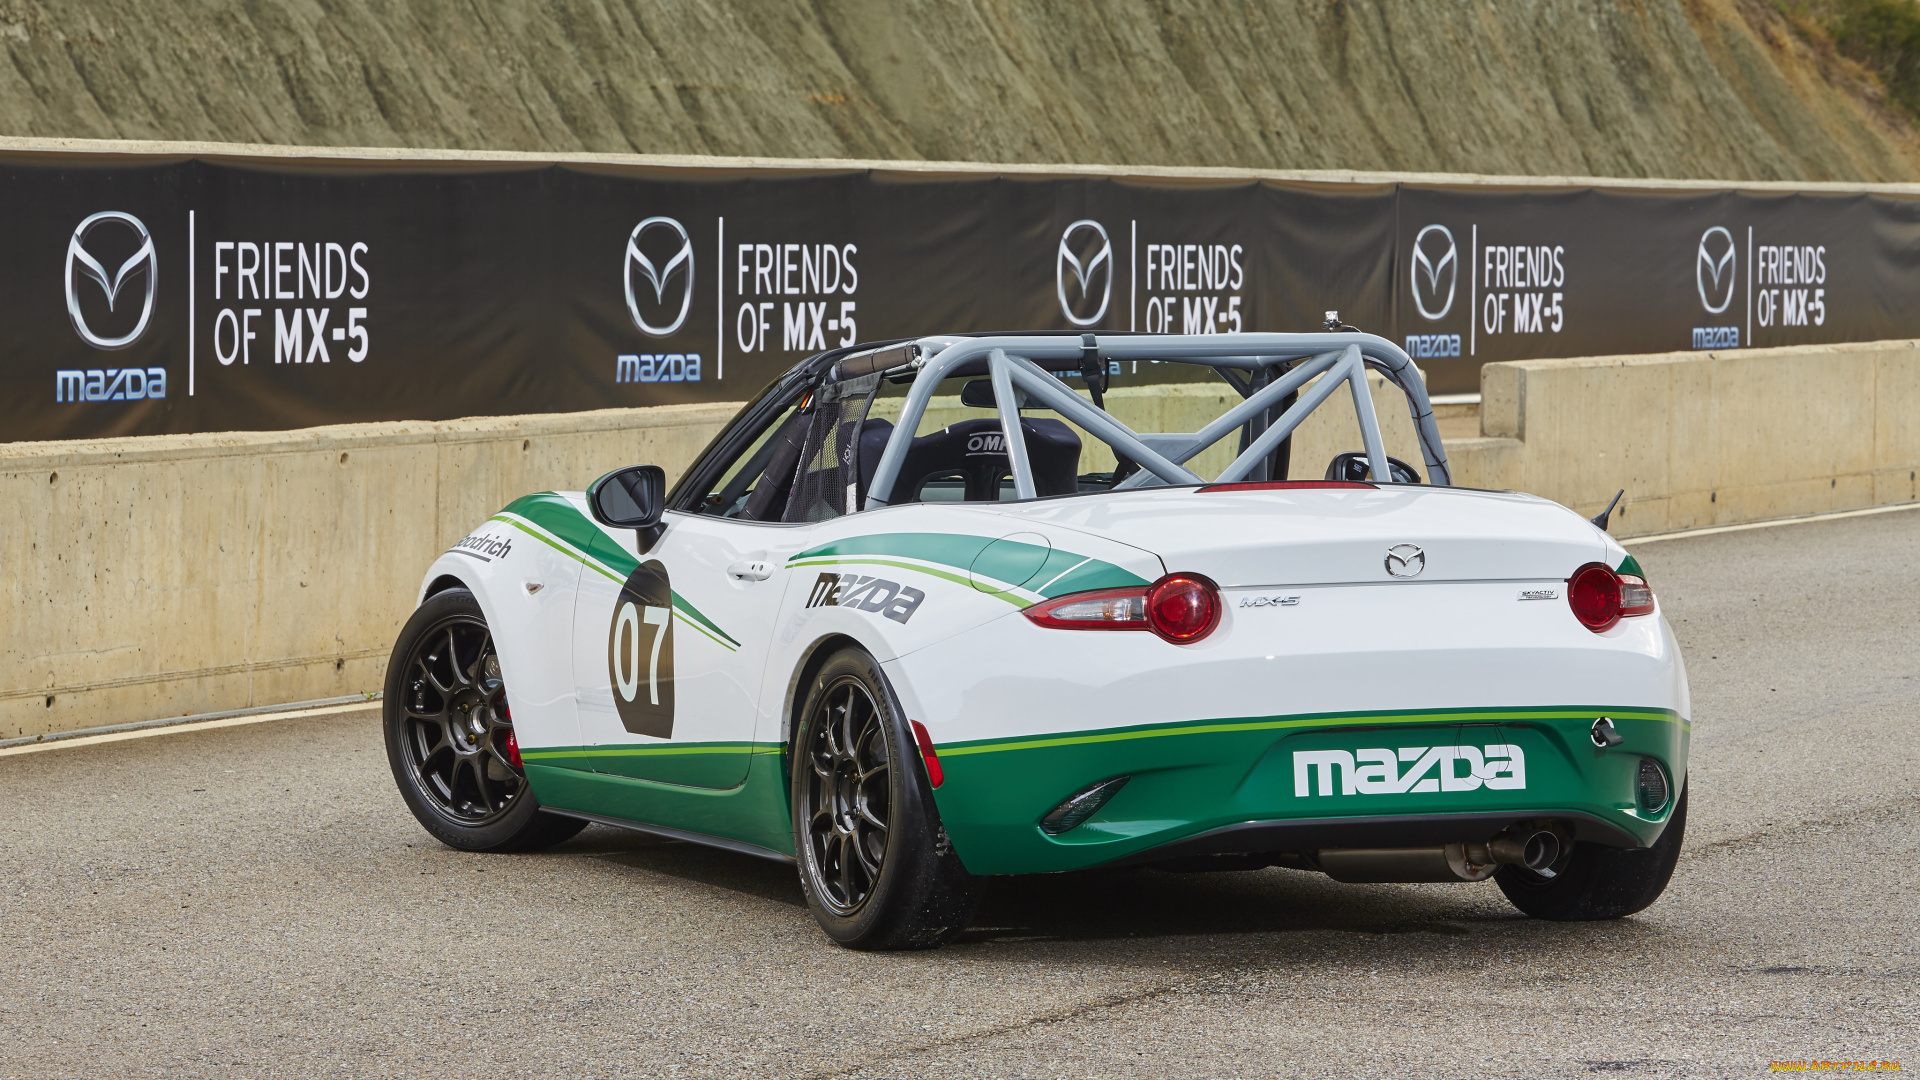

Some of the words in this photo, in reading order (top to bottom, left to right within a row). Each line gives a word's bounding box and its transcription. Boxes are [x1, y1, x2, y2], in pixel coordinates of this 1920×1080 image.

[215, 242, 369, 299] FRIENDS
[738, 244, 858, 295] FRIENDS
[1147, 245, 1243, 290] FRIENDS
[1485, 246, 1565, 288] FRIENDS
[1758, 246, 1826, 285] FRIENDS
[737, 302, 775, 353] OF
[783, 301, 857, 352] MX-5
[1146, 297, 1177, 333] OF
[1183, 296, 1242, 334] MX-5
[1483, 292, 1510, 335] OF
[1514, 292, 1564, 334] MX-5
[1757, 289, 1780, 327] OF
[1783, 289, 1826, 326] MX-5
[214, 308, 262, 366] OF
[274, 307, 369, 364] MX-5
[1405, 333, 1461, 359] mazda
[1692, 326, 1740, 349] mazda
[56, 366, 167, 402] mazda
[616, 353, 701, 383] mazda
[805, 572, 926, 625] mazda
[1239, 595, 1301, 608] MX-5
[613, 601, 671, 706] 07
[1292, 744, 1527, 798] mazda
